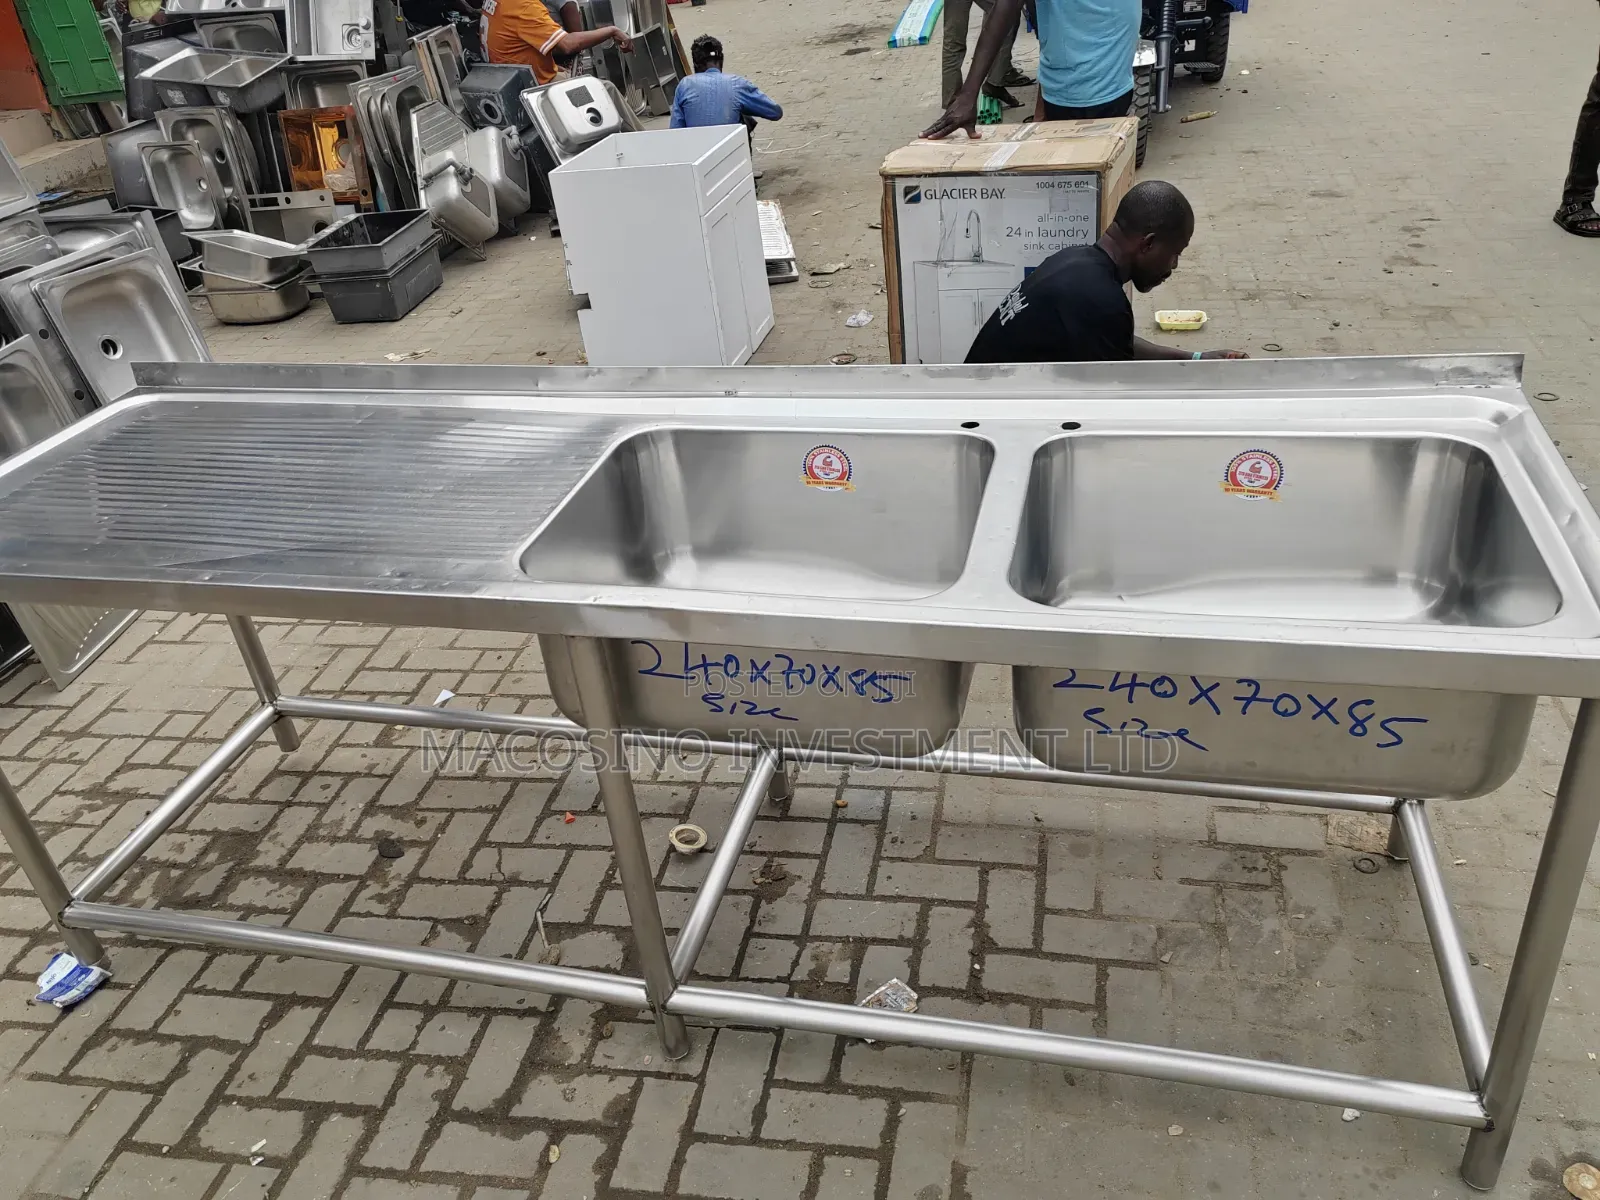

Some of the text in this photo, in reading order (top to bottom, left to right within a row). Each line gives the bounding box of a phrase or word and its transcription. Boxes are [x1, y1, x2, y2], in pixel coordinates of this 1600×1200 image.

[924, 188, 1005, 200] GLACIER BAY
[1037, 213, 1089, 223] all-in-one
[1005, 226, 1089, 239] 24 in laundry
[1023, 241, 1045, 250] sink
